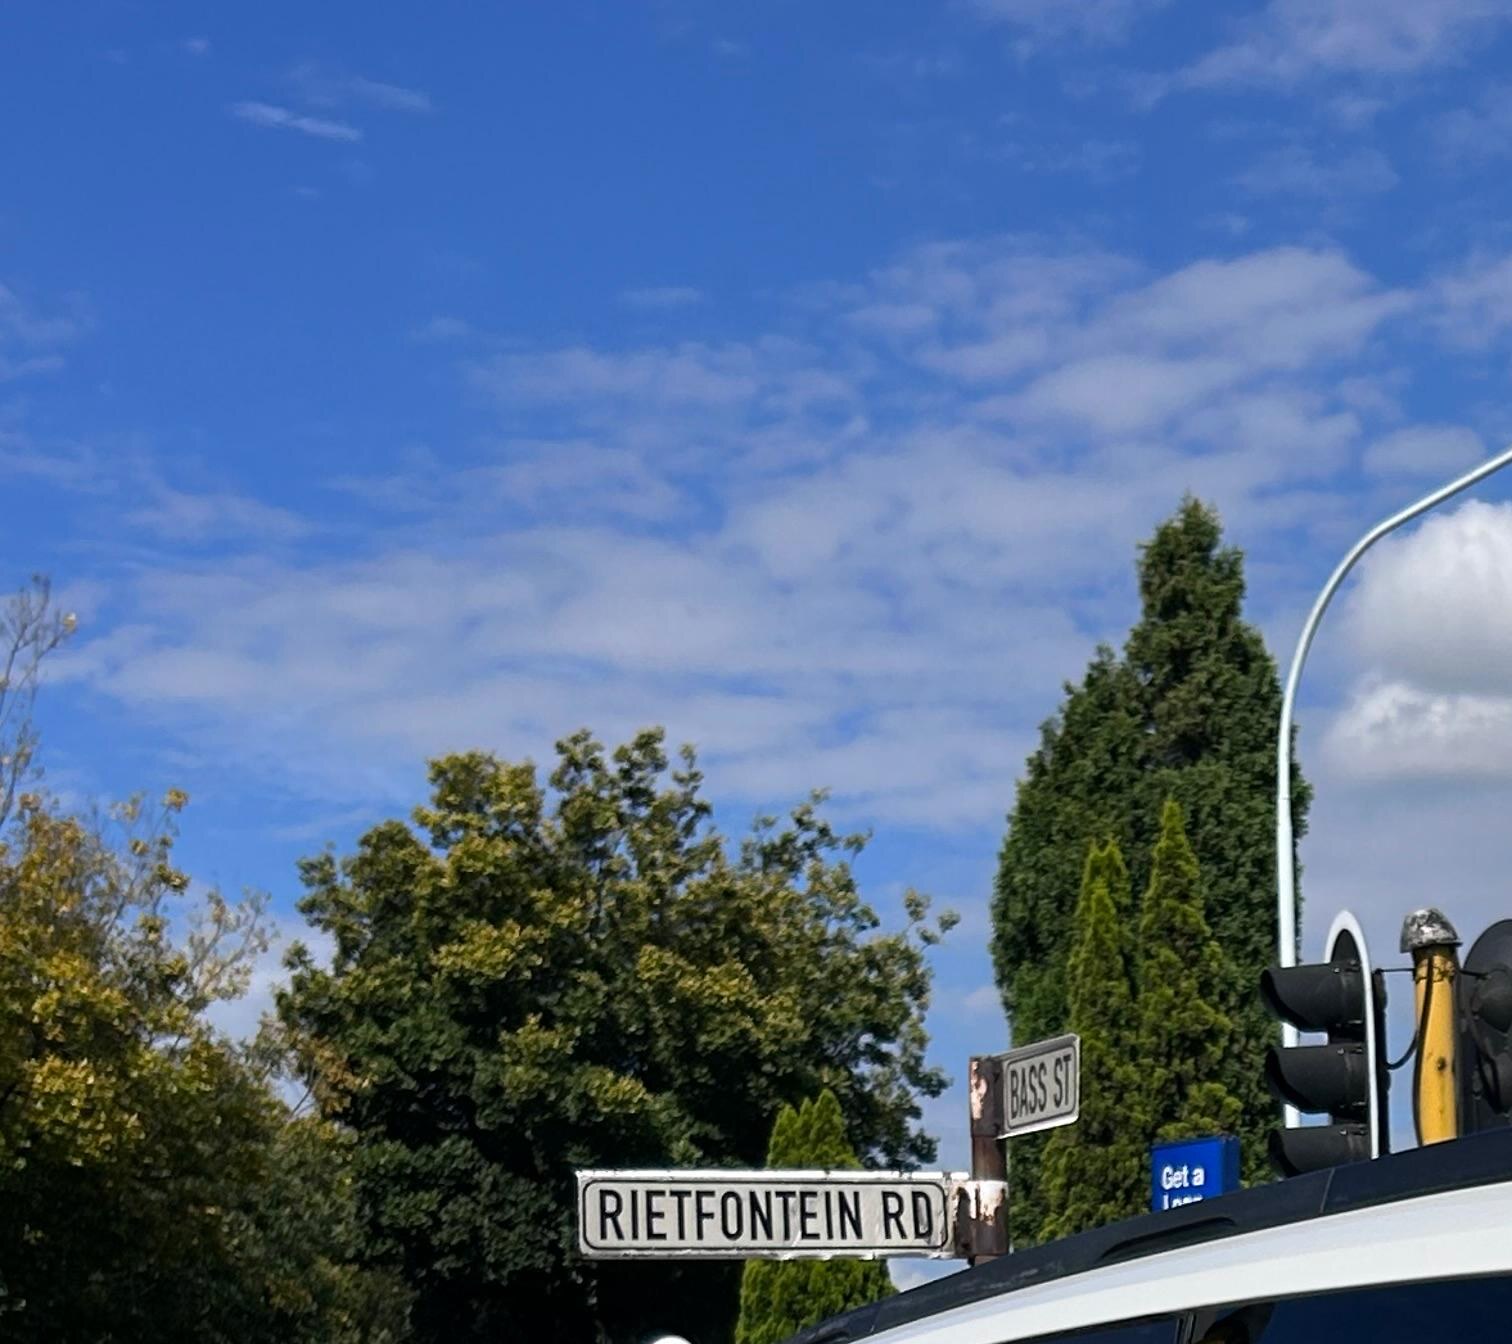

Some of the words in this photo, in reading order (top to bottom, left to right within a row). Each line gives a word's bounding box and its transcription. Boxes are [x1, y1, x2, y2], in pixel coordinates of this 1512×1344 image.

[1010, 1062, 1048, 1119] BASS
[1054, 1054, 1072, 1109] ST
[1161, 1165, 1189, 1190] Get
[1191, 1170, 1205, 1186] a
[598, 1188, 864, 1242] RIETFONTEIN
[883, 1190, 934, 1241] RD
